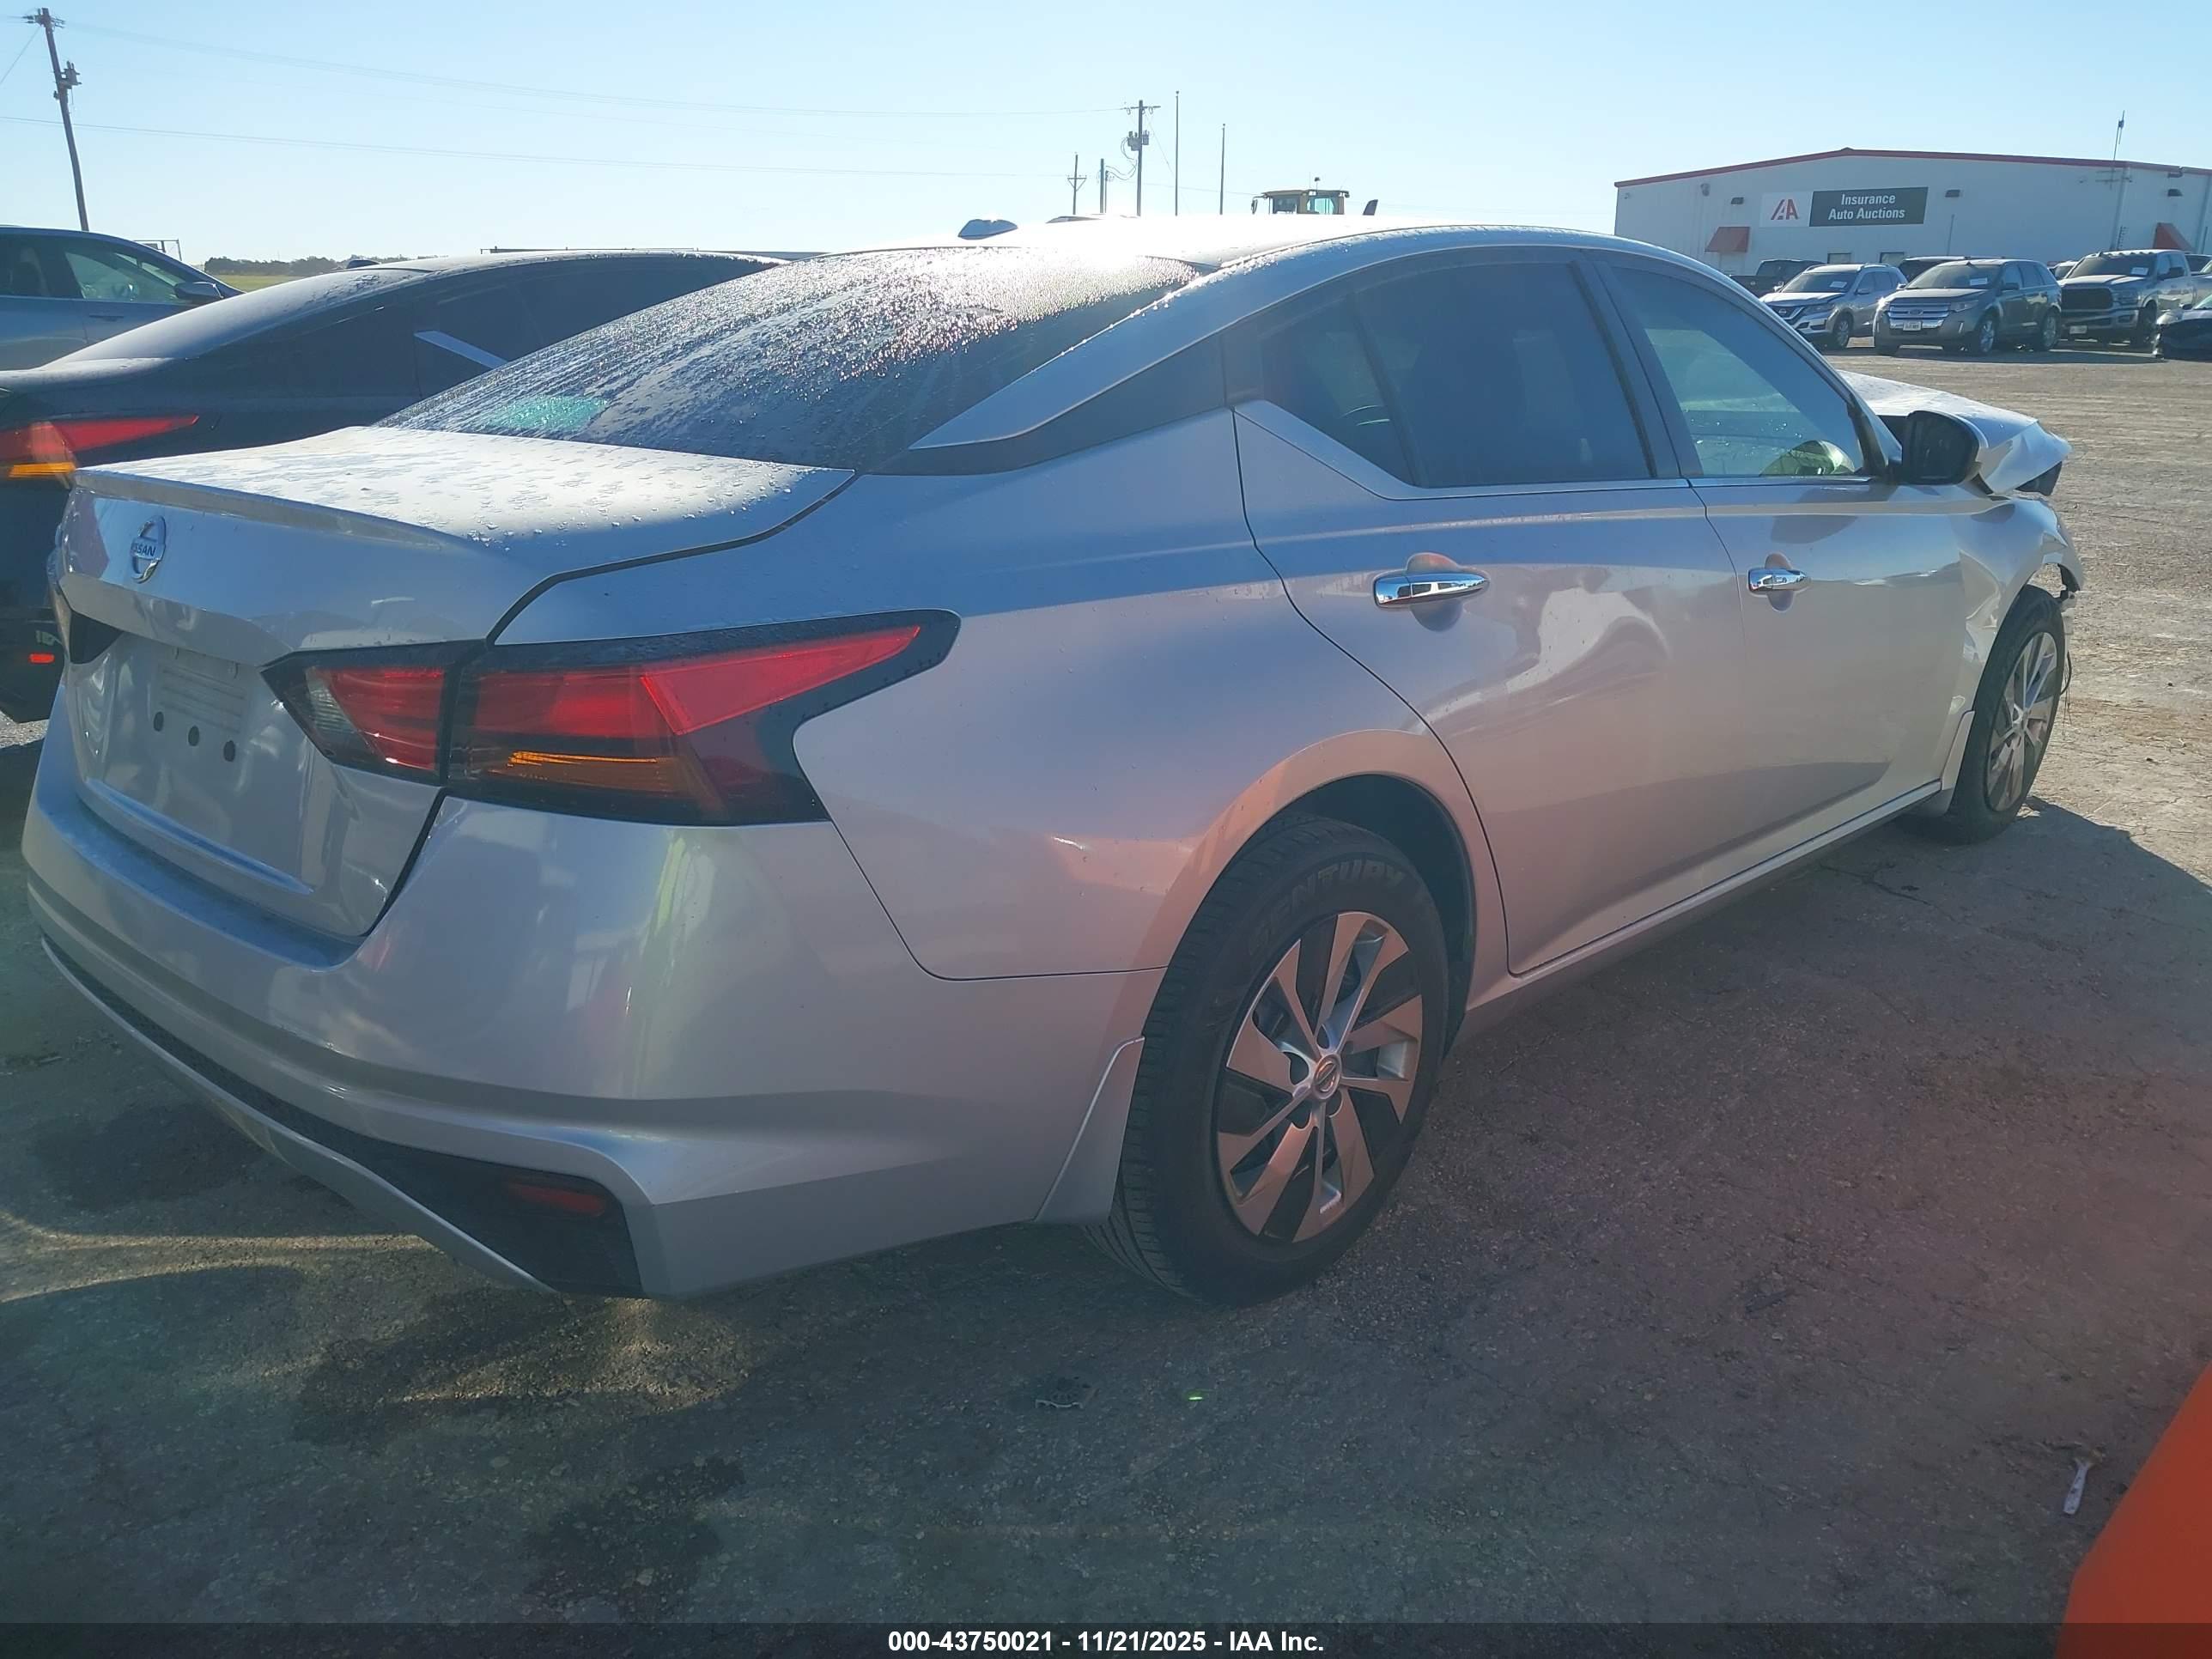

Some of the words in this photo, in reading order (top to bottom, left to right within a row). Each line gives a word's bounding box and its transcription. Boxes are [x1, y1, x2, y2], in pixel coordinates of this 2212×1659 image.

[1840, 193, 1896, 205] Insurance
[1827, 208, 1854, 221] Auto
[1856, 207, 1905, 220] Auctions
[131, 541, 156, 557] SSAN
